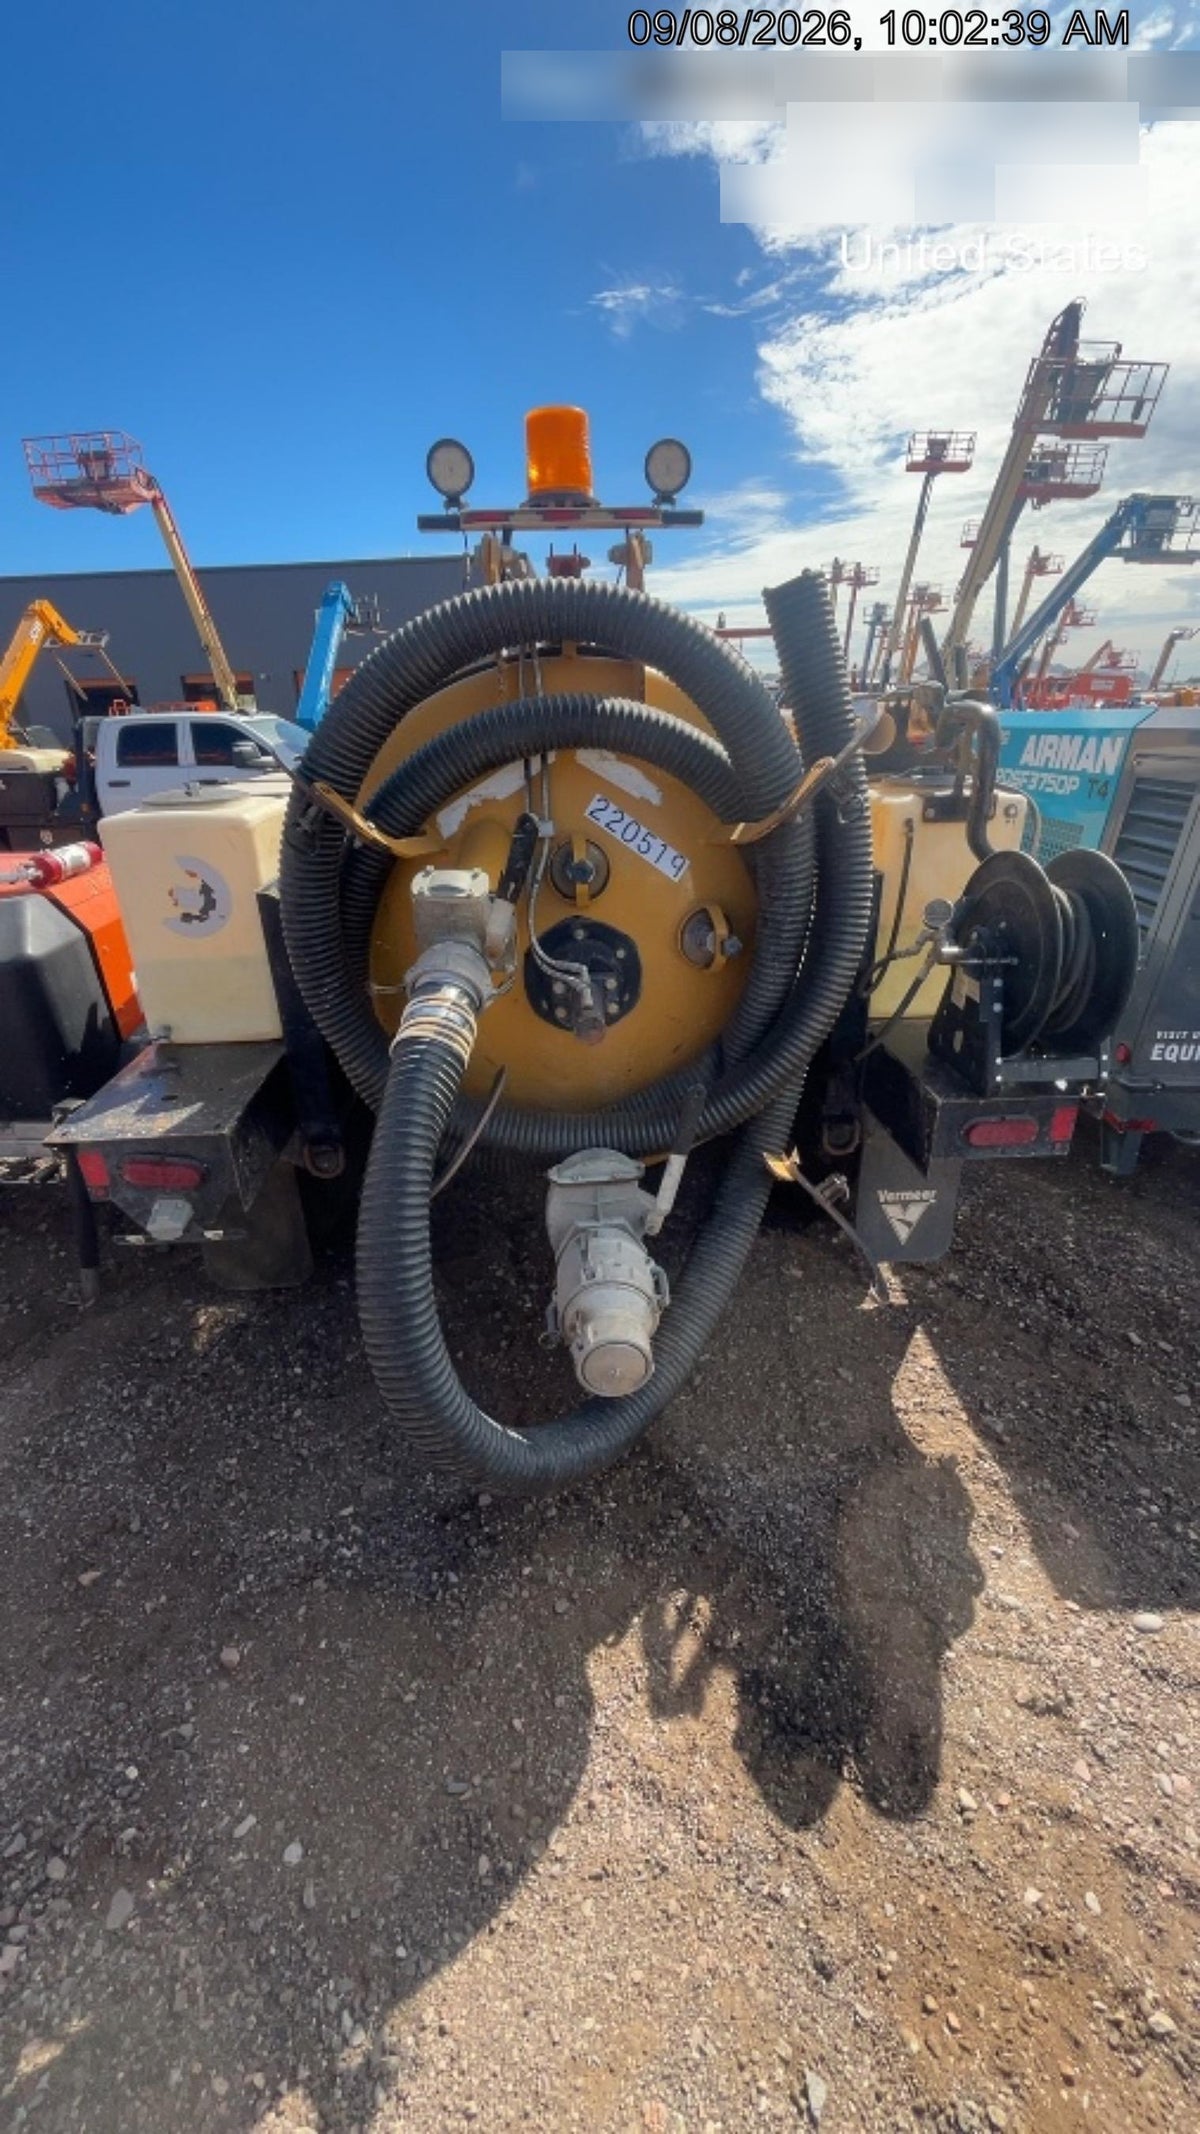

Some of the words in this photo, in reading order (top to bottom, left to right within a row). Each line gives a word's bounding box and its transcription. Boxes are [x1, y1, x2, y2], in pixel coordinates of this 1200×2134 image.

[1020, 733, 1125, 776] AIRMAN
[1087, 776, 1109, 799] T4
[588, 797, 687, 878] 220519
[877, 1188, 937, 1203] Vermeer
